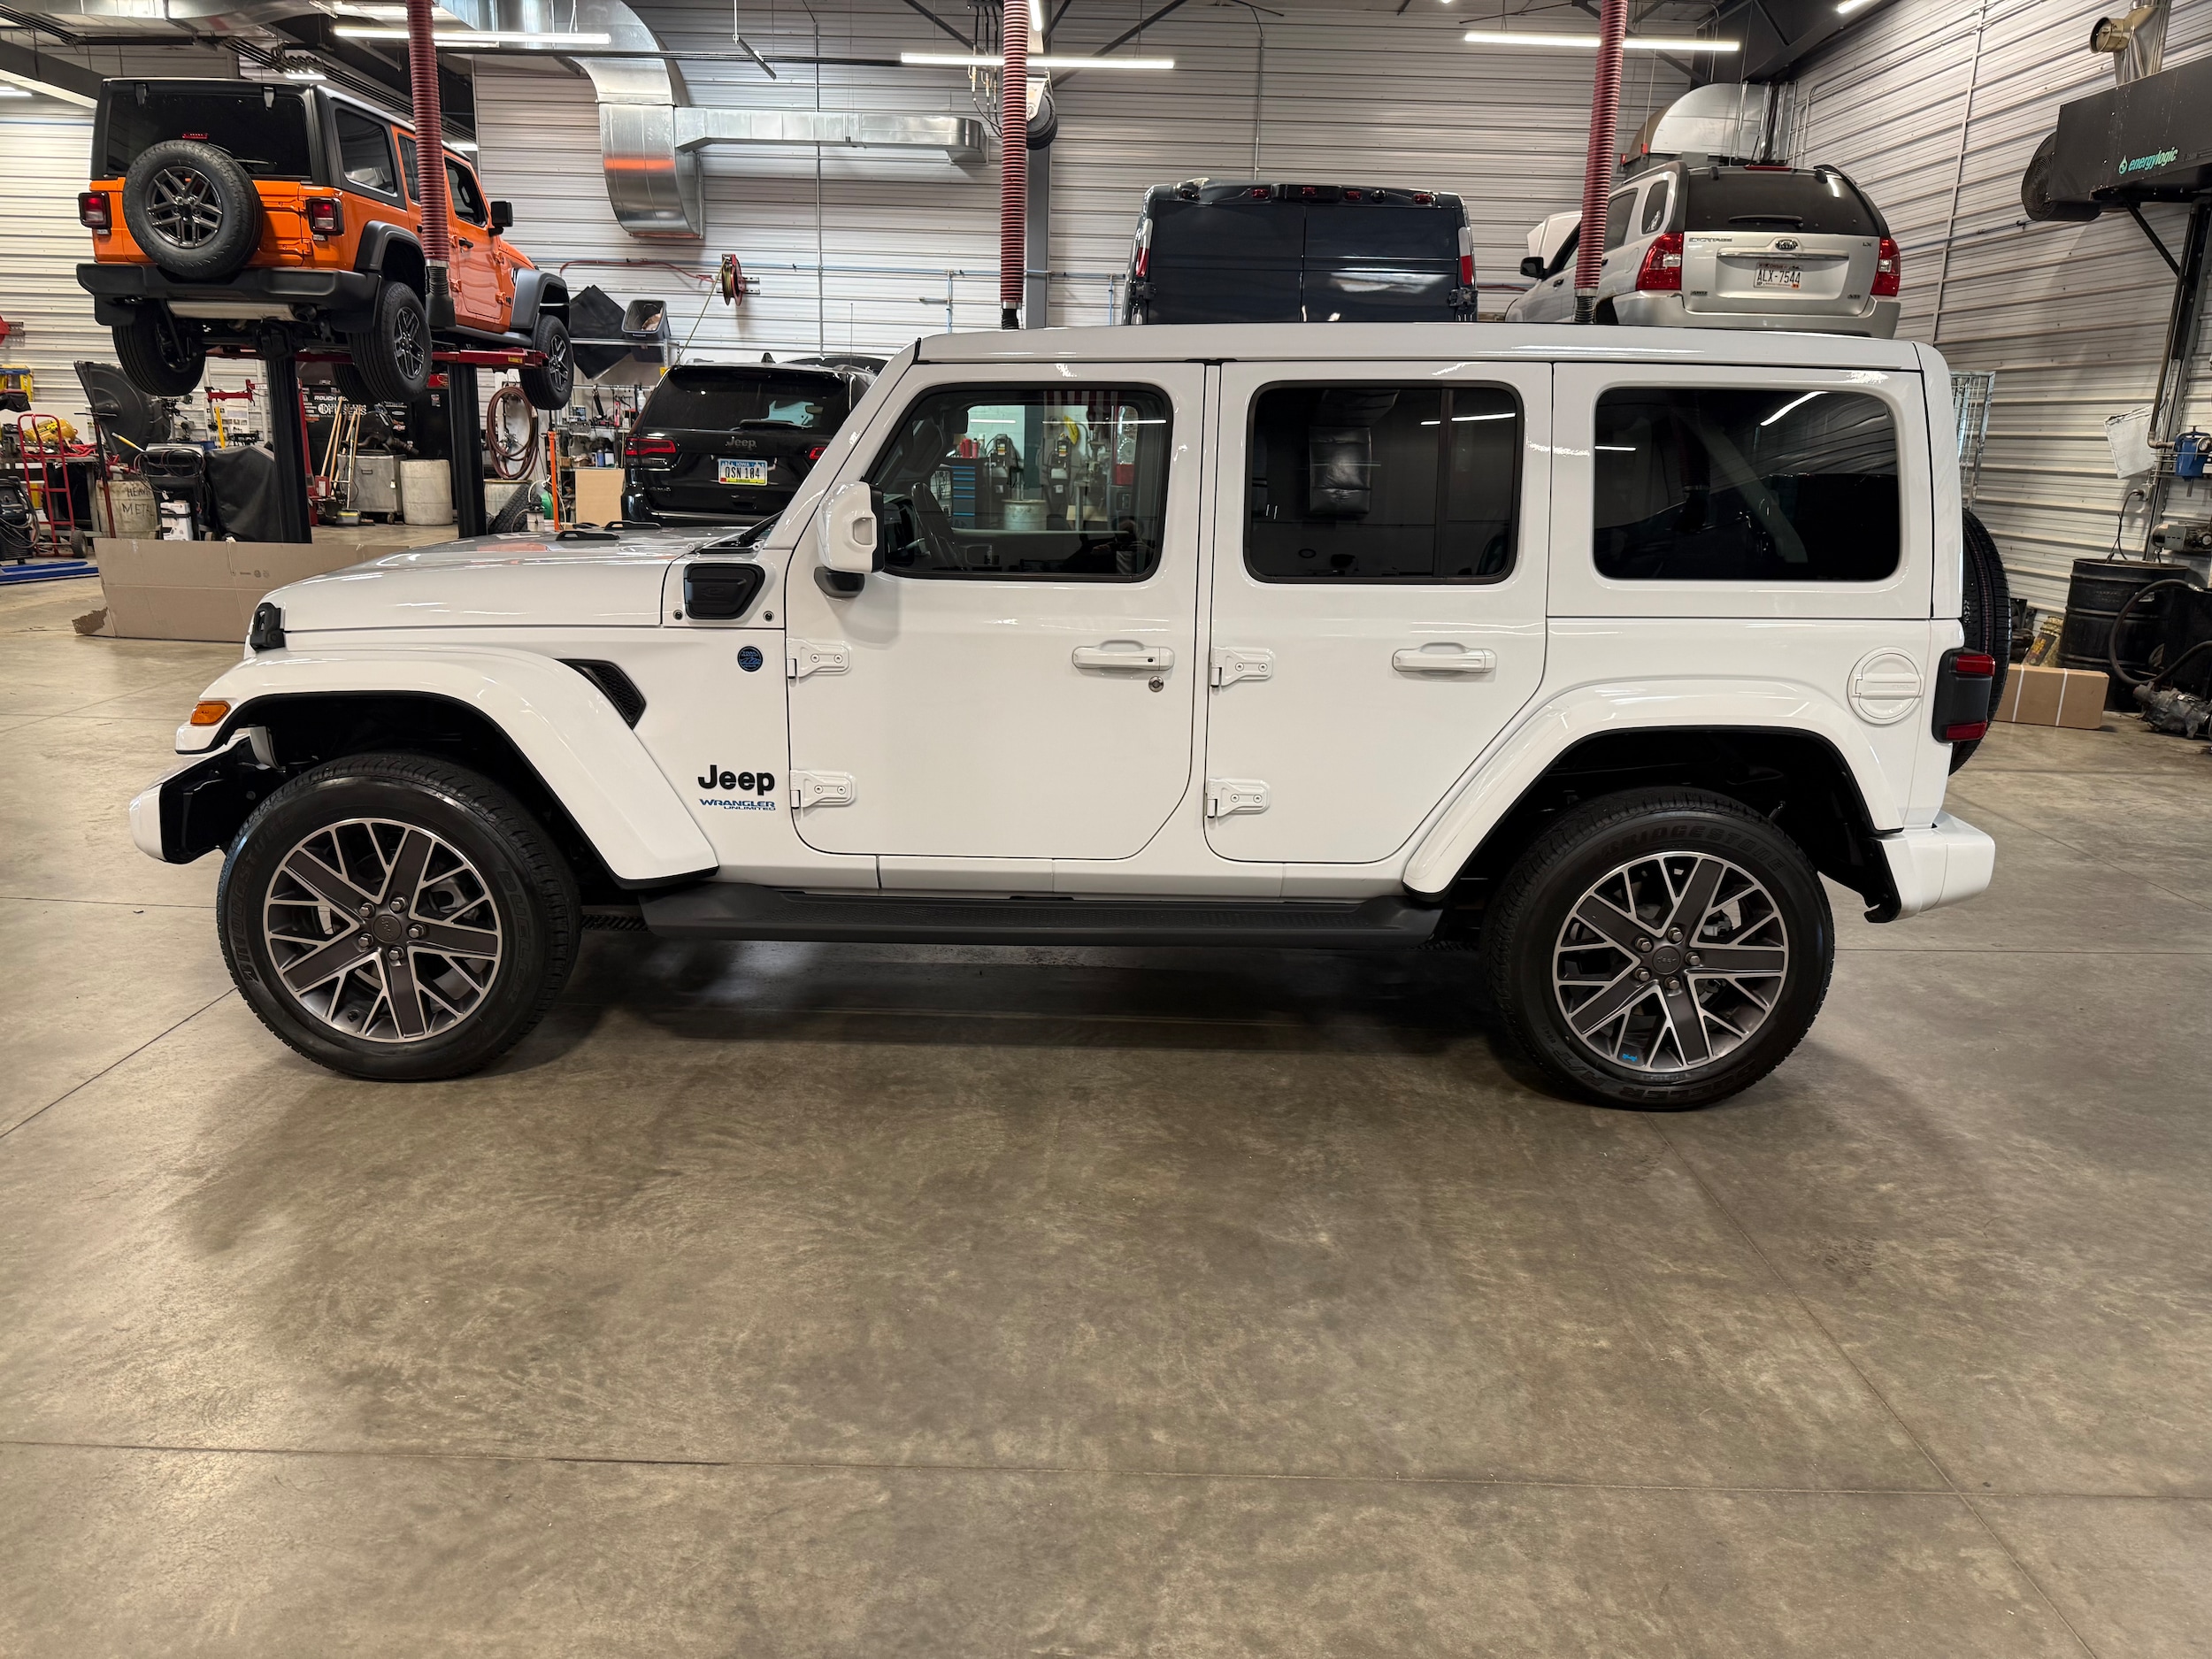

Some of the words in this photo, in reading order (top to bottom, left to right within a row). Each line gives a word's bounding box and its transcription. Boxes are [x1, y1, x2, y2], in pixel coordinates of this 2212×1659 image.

[2128, 147, 2178, 172] energylogic
[1756, 269, 1801, 284] ALX-7544
[726, 436, 757, 449] Jeep
[697, 764, 775, 795] Jeep
[699, 798, 776, 808] WRANGLER
